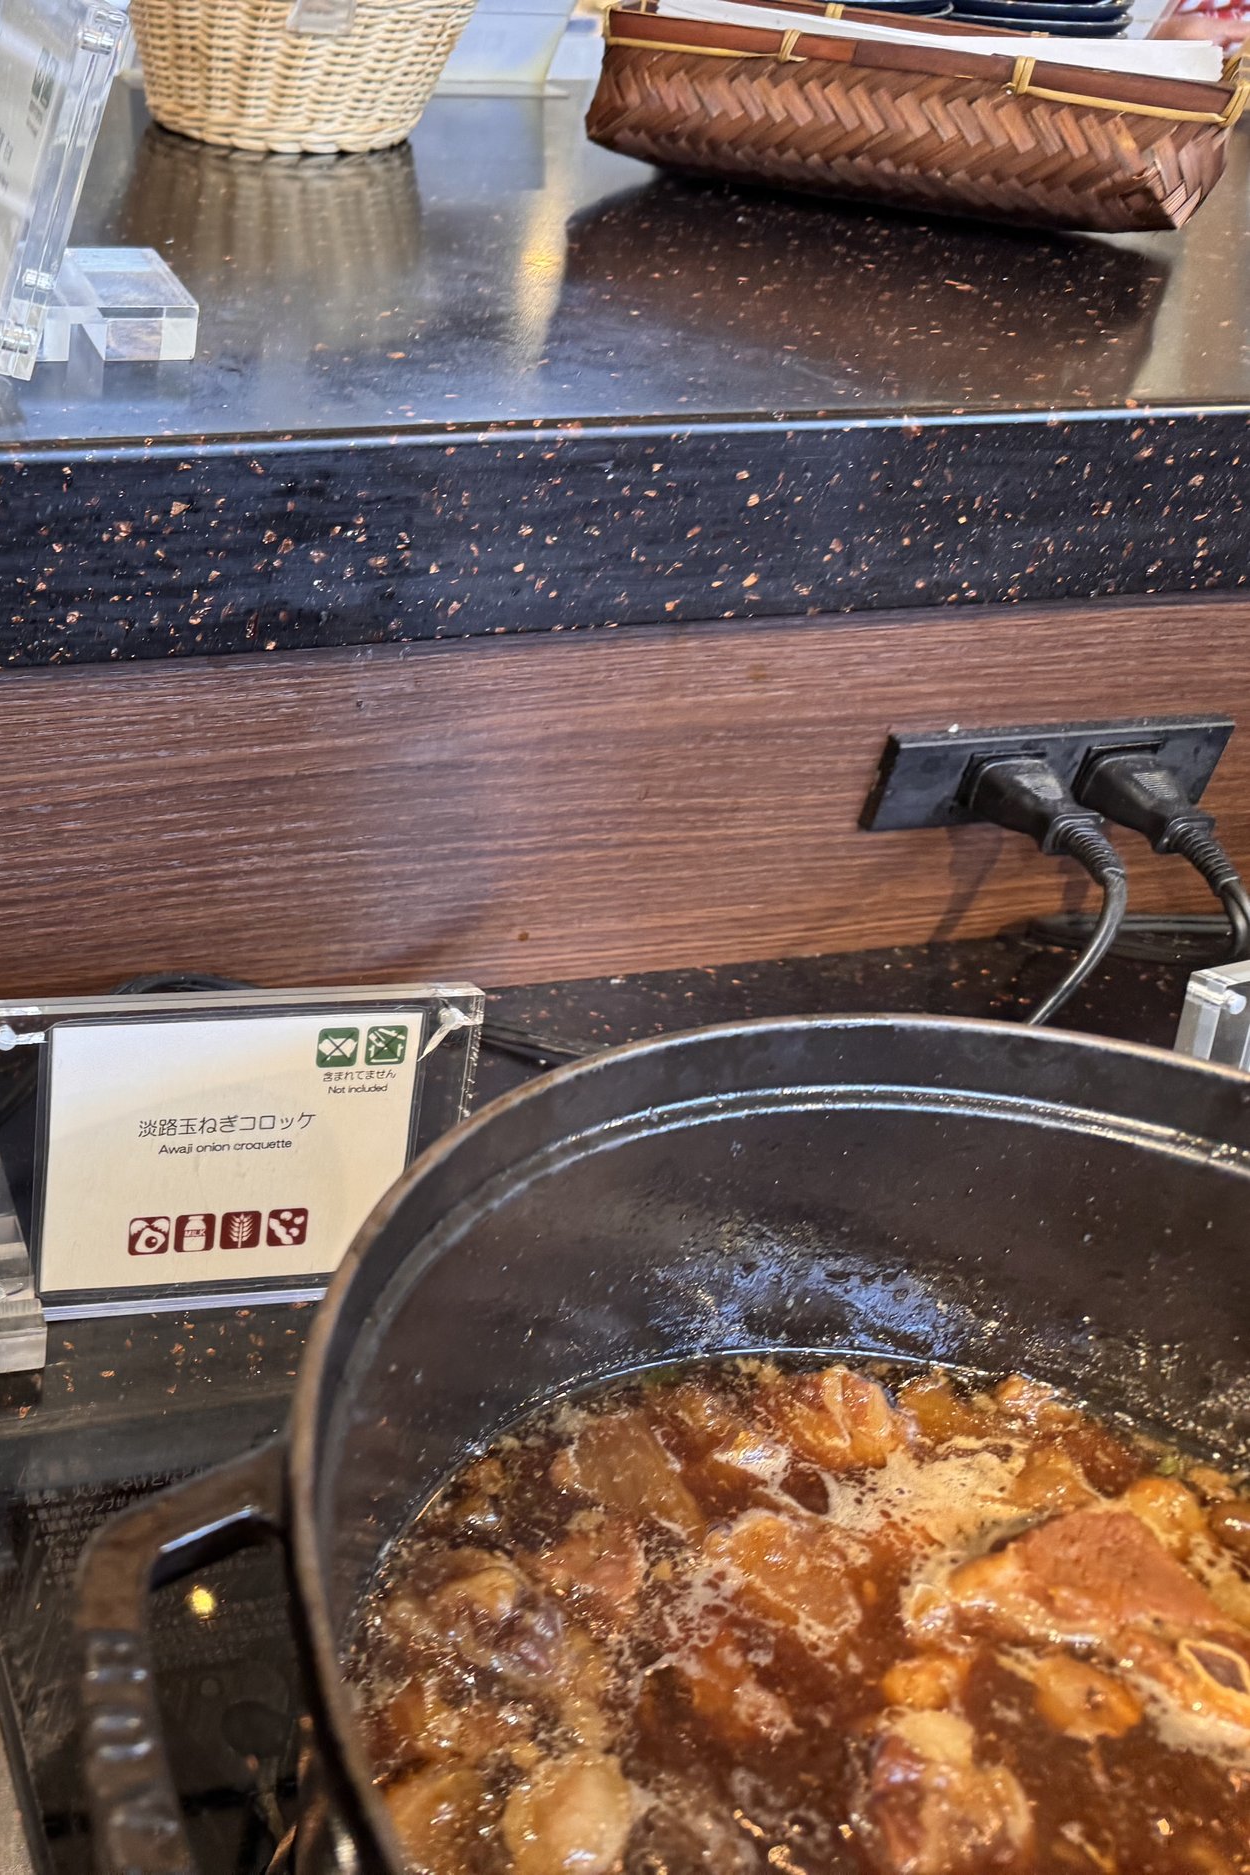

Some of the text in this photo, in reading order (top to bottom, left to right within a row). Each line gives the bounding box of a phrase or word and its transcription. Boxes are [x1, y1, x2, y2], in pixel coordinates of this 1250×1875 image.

[323, 1069, 396, 1082] 含まれてません
[328, 1084, 388, 1094] Not included
[138, 1112, 316, 1137] 淡路玉ねぎコロッケ
[158, 1139, 292, 1155] Awaji onion croquette
[184, 1229, 206, 1237] MILK
